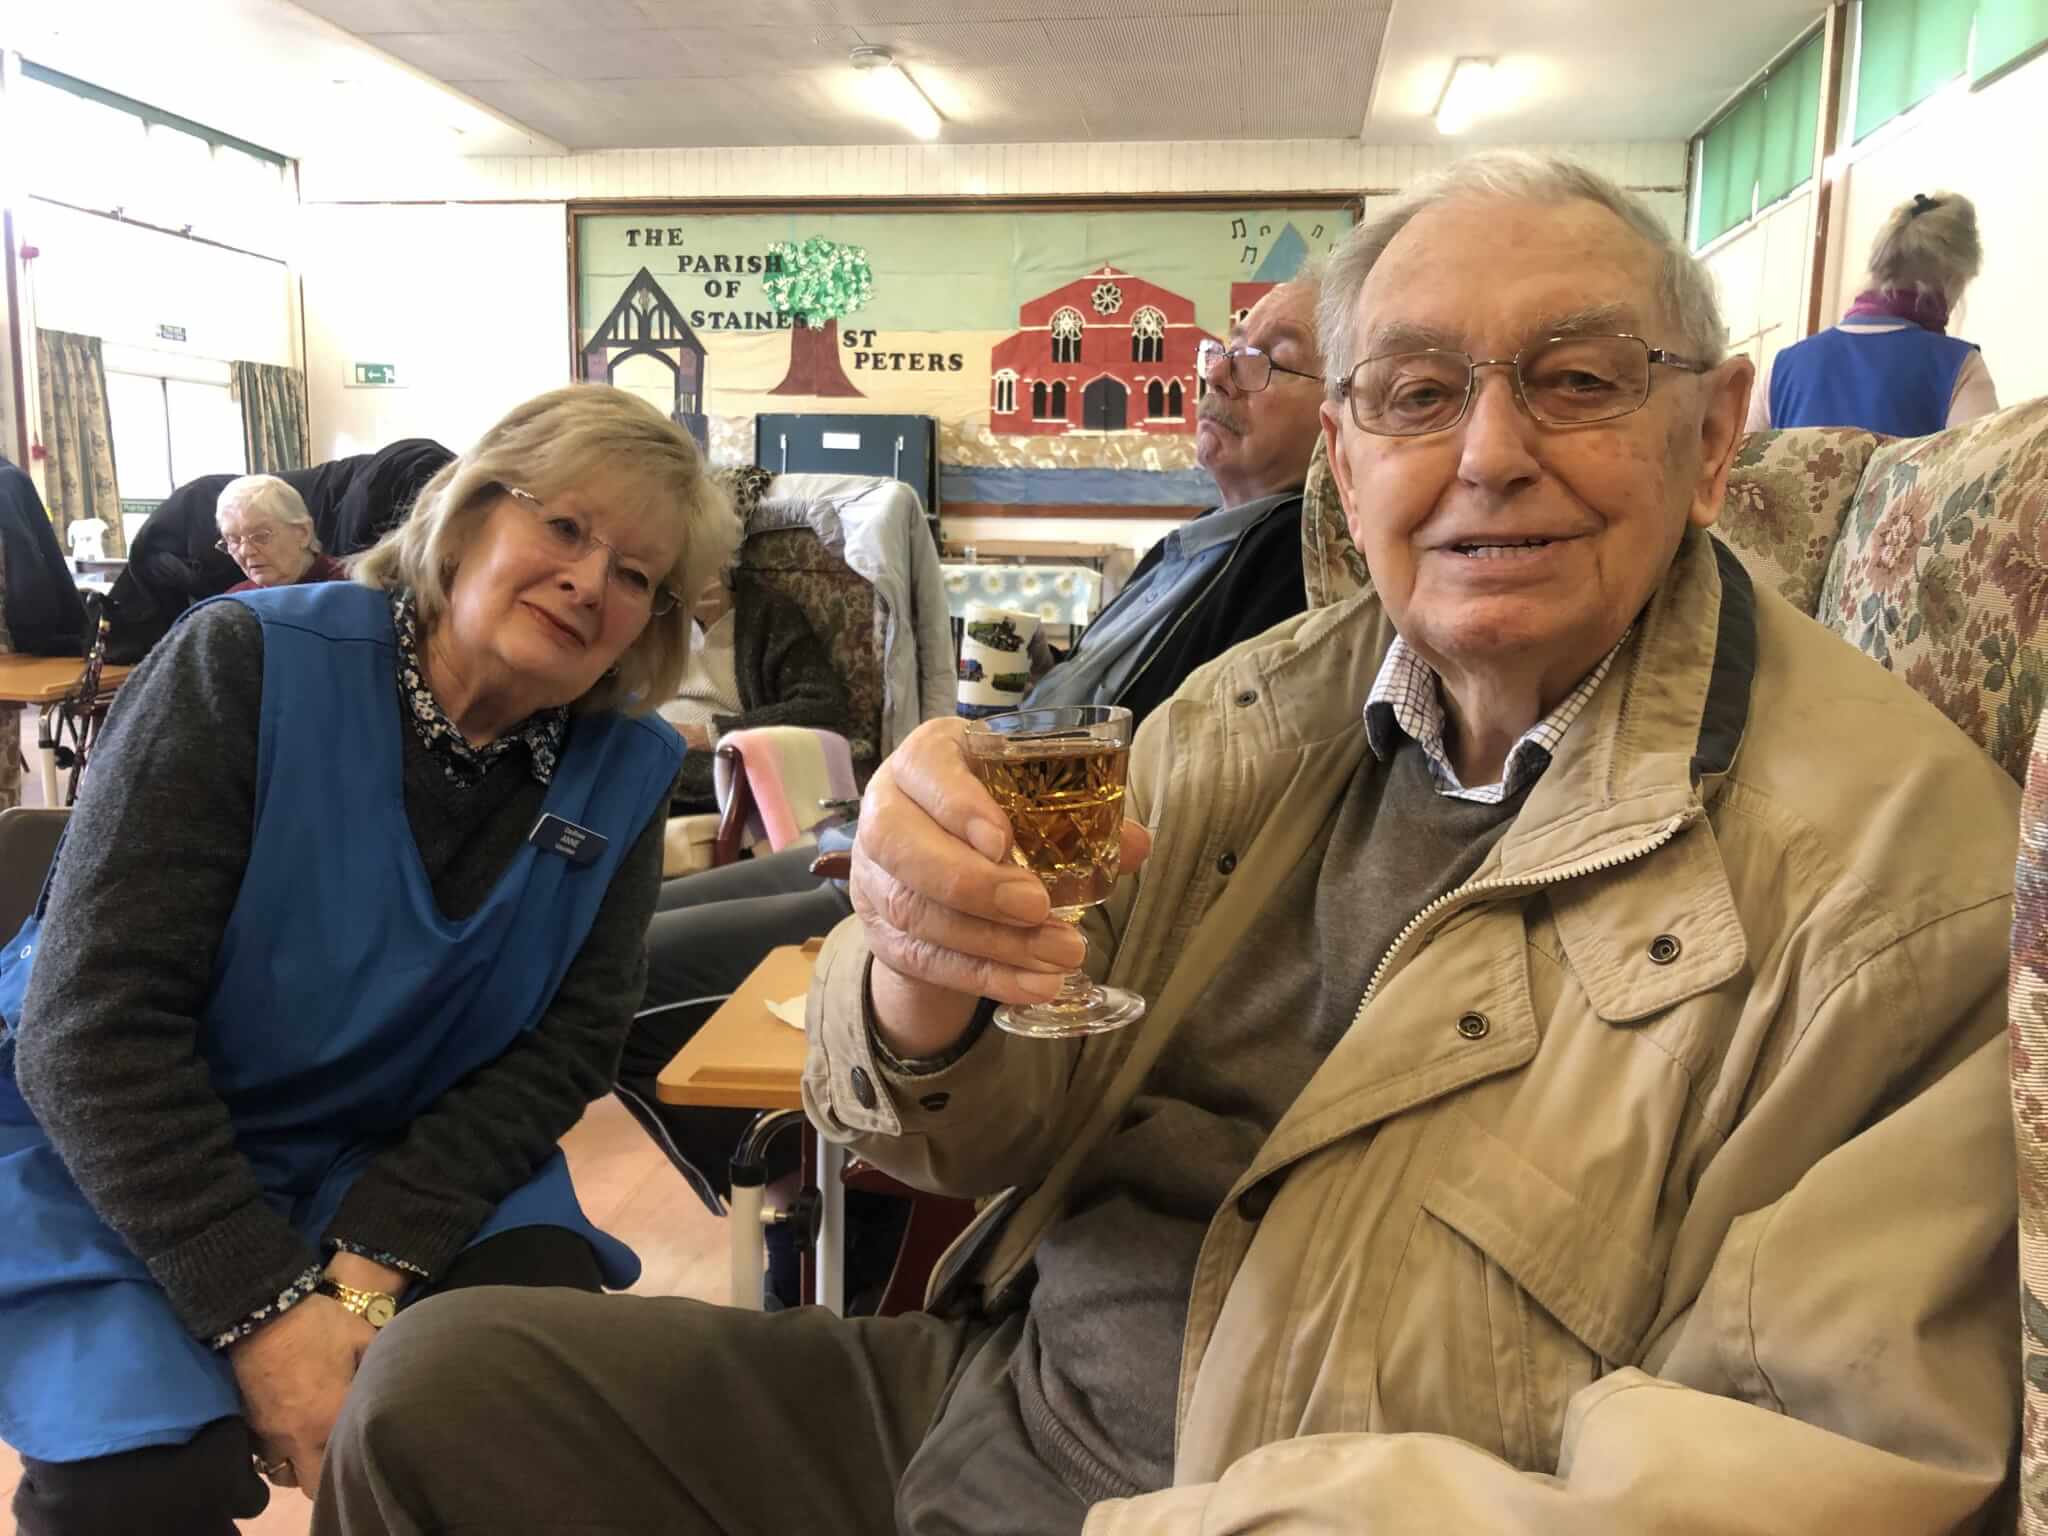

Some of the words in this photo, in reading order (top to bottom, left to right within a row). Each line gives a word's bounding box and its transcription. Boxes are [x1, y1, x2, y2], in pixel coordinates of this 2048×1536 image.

[626, 228, 684, 247] THE
[677, 254, 784, 273] PARISH
[704, 279, 741, 298] OF
[690, 309, 809, 330] STAINES
[842, 329, 878, 348] ST
[854, 351, 964, 371] PETERS
